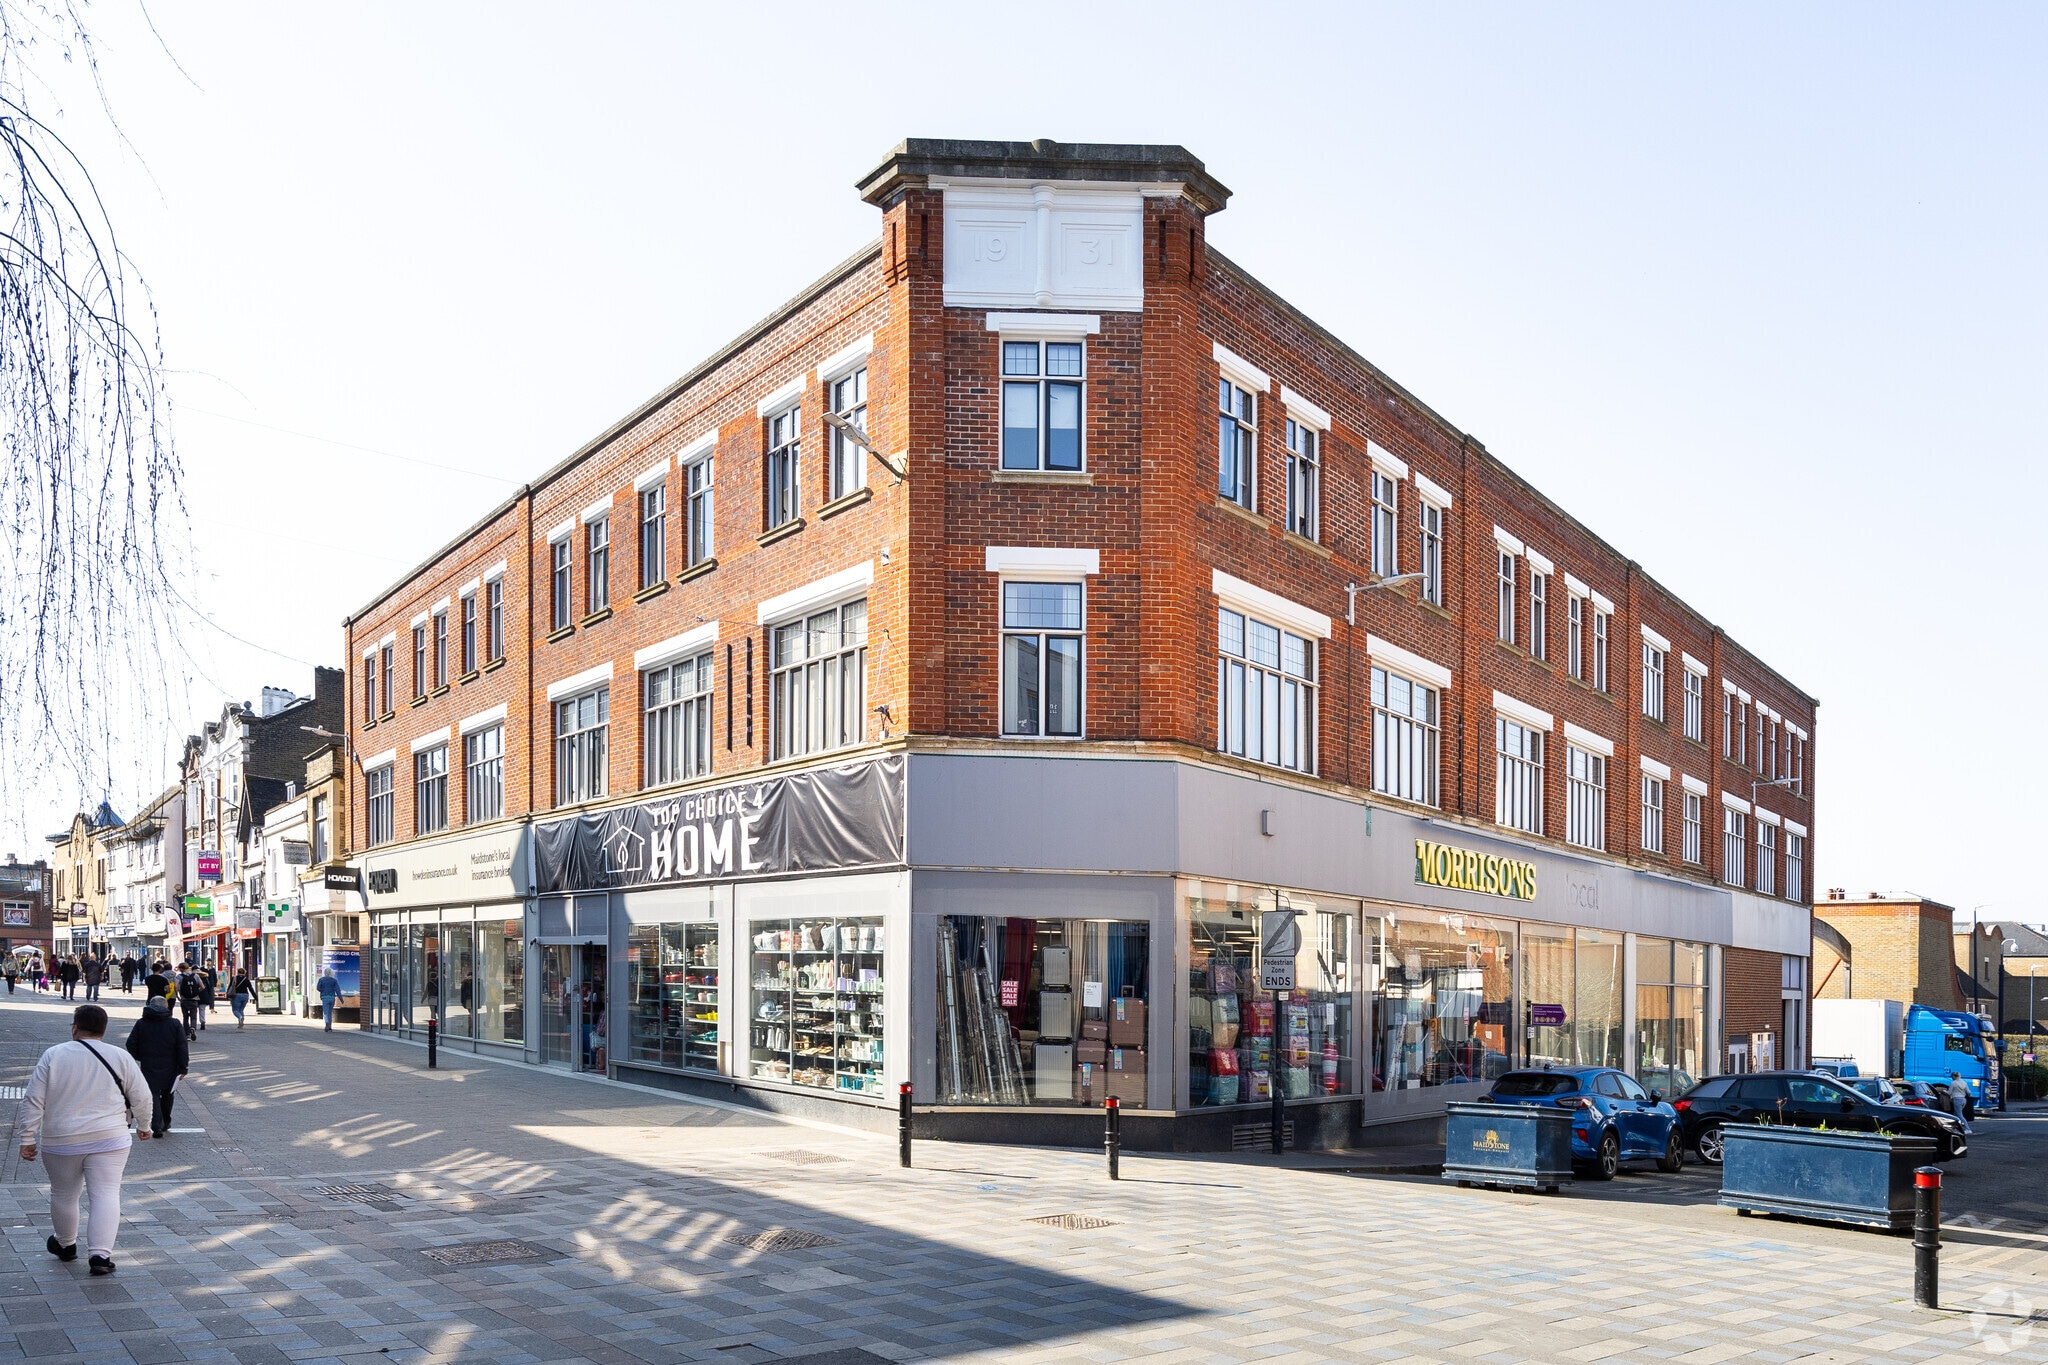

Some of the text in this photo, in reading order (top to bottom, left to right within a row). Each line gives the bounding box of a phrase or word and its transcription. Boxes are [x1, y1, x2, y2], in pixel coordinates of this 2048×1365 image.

[972, 231, 1115, 267] 19 31
[652, 788, 765, 827] TOP CHOICE 4
[470, 847, 511, 865] Maidstone's local
[650, 814, 765, 880] HOME
[327, 874, 357, 883] HOWDEN
[412, 863, 458, 881] howdeninsurance.co.uk
[471, 869, 494, 881] insurance
[1415, 840, 1537, 901] MORRISONS
[1263, 958, 1294, 966] Pedestrian
[1265, 976, 1291, 986] ENDS
[1472, 1140, 1510, 1150] MAIDSTONE
